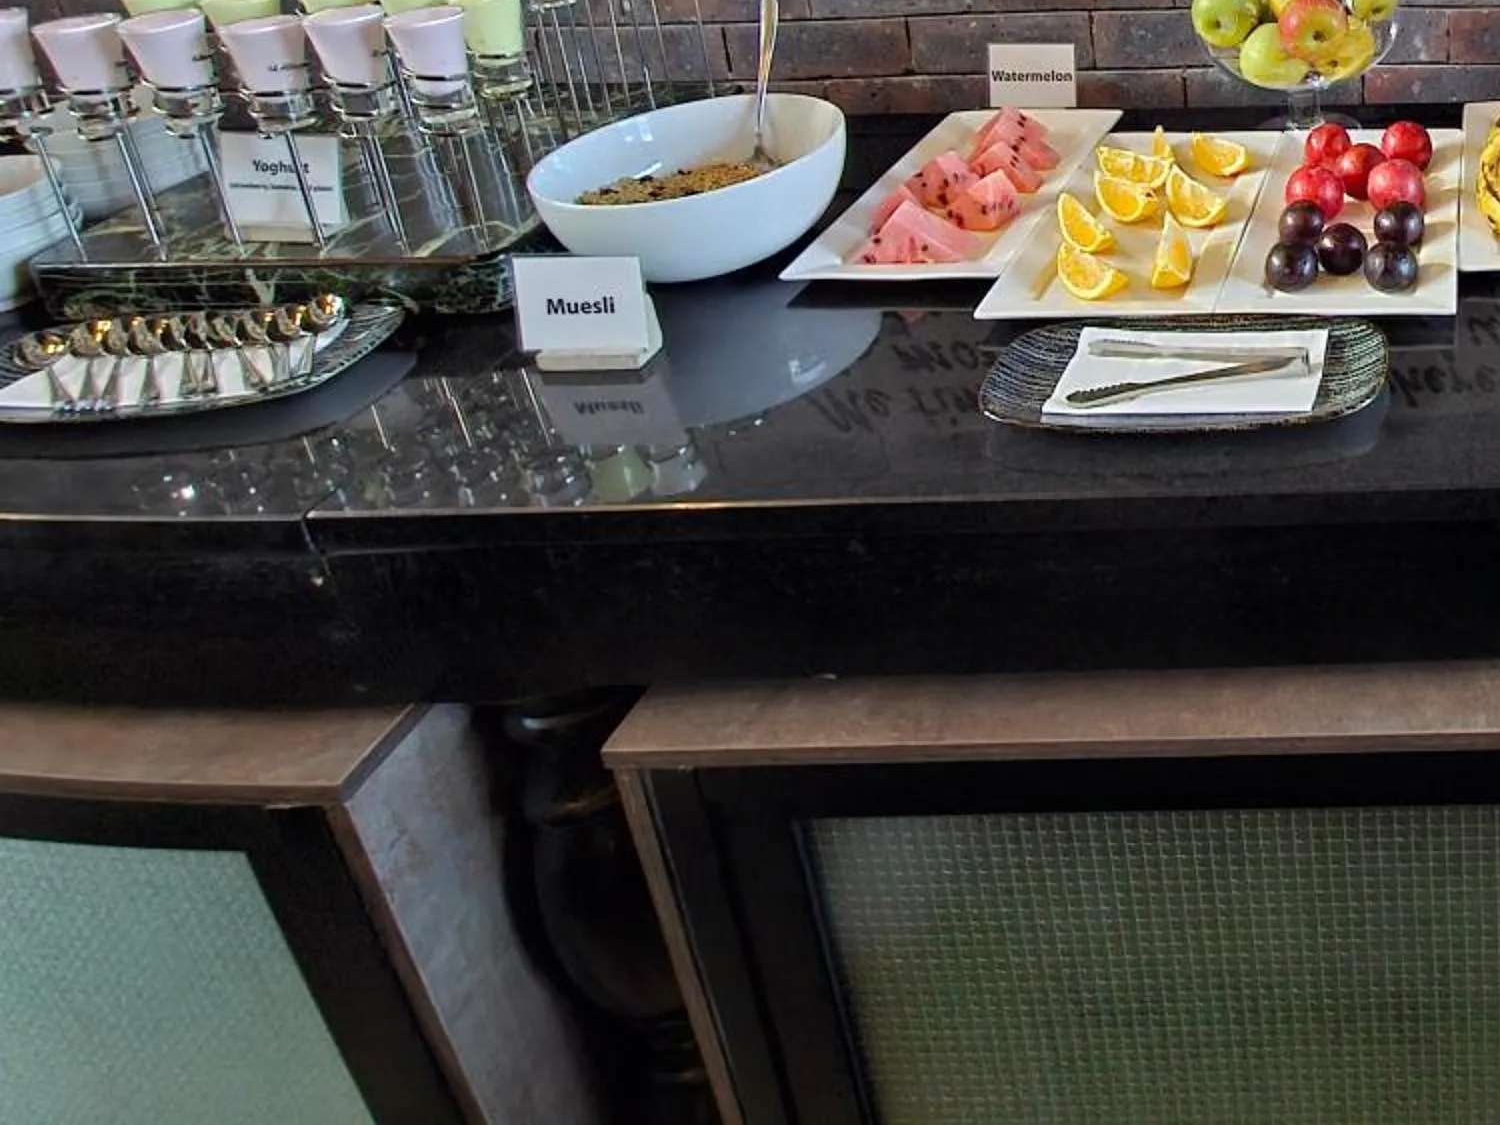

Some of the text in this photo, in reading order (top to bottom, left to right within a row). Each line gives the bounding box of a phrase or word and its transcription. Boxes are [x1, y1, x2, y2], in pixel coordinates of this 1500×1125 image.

[991, 69, 1073, 83] Watermelon
[252, 159, 311, 176] Yoghut
[546, 296, 615, 316] Muesli
